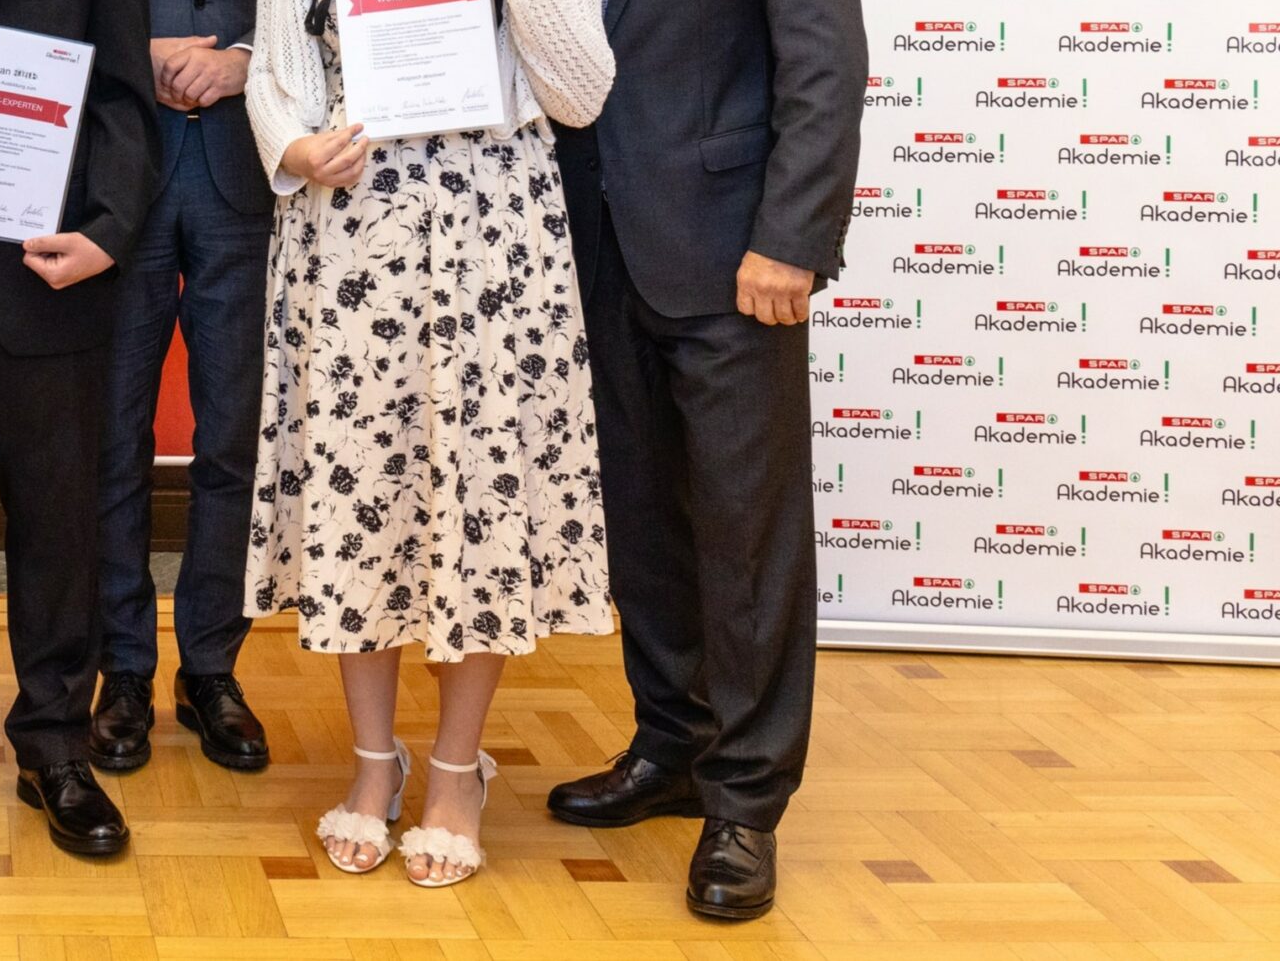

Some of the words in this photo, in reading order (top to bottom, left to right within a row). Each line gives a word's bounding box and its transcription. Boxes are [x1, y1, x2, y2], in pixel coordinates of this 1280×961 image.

[924, 23, 963, 31] SPAR
[923, 134, 963, 142] SPAR
[1089, 136, 1127, 144] SPAR
[1005, 191, 1046, 199] SPAR
[1173, 193, 1215, 201] SPAR
[1088, 248, 1128, 256] SPAR
[842, 299, 881, 308] SPAR
[1005, 303, 1045, 311] SPAR
[1172, 306, 1214, 315] SPAR
[922, 356, 963, 365] SPAR
[1005, 414, 1045, 423] SPAR
[1171, 418, 1213, 427] SPAR
[922, 467, 962, 477] SPAR
[1087, 473, 1128, 481] SPAR
[1004, 526, 1044, 535] SPAR
[1171, 531, 1212, 540] SPAR
[922, 578, 962, 588] SPAR
[1087, 585, 1128, 594] SPAR
